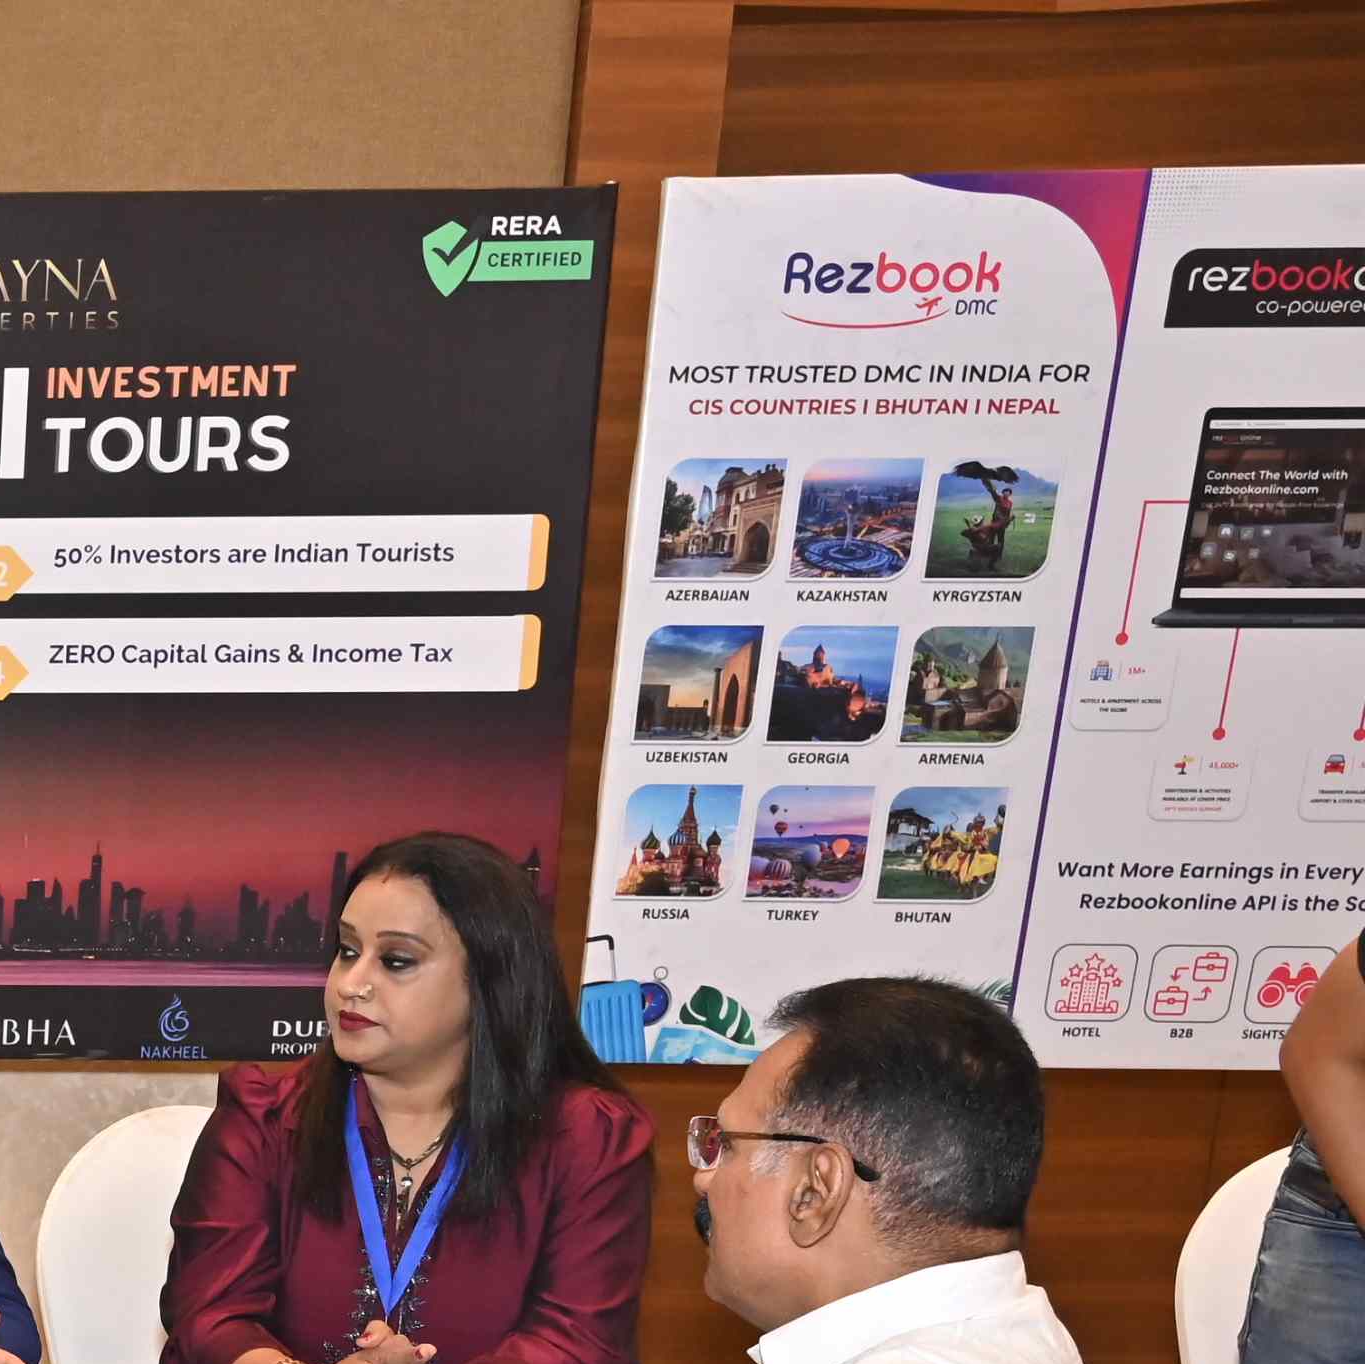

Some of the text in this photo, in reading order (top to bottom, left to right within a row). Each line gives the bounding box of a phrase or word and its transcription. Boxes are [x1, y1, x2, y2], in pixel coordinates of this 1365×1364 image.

[491, 215, 562, 236] RERA
[487, 251, 582, 269] CERTIFIED
[782, 250, 1002, 295] Rezbook
[955, 300, 997, 315] DMC
[1255, 300, 1365, 316] co-powere
[669, 364, 1090, 384] MOST TRUSTED DMC IN INDIA FOR
[46, 365, 297, 399] INVESTMENT
[689, 399, 723, 415] CIS
[729, 399, 857, 415] COUNTRIES
[875, 399, 969, 415] BHUTAN
[987, 399, 1060, 415] NEPAL
[43, 415, 291, 474] TOURS
[1206, 470, 1348, 480] Connect The World with
[54, 542, 454, 566] 50% Investors are Indian Tourists
[665, 589, 750, 601] AZERBAIJAN
[796, 589, 888, 602] KAZAKHSTAN
[933, 590, 1023, 602] KYRGYZSTAN
[49, 643, 453, 668] ZERO Capital Gains & Income Tax
[645, 751, 728, 764] UZBEKISTAN
[788, 752, 850, 765] GEORGIA
[918, 753, 985, 766] ARMENIA
[1058, 862, 1365, 885] Want More Earnings in Every
[1079, 893, 1237, 911] Rezbookonline
[1242, 895, 1276, 911] API
[1282, 896, 1298, 911] is
[1305, 896, 1339, 911] the
[642, 908, 690, 921] RUSSIA
[767, 908, 819, 922] TURKEY
[894, 911, 951, 924] BHUTAN
[272, 1020, 330, 1037] DUB
[1062, 1027, 1101, 1038] HOTEL
[1170, 1028, 1193, 1039] B2B
[1242, 1029, 1285, 1040] SIGHTS
[140, 1045, 207, 1059] NAKHEEL
